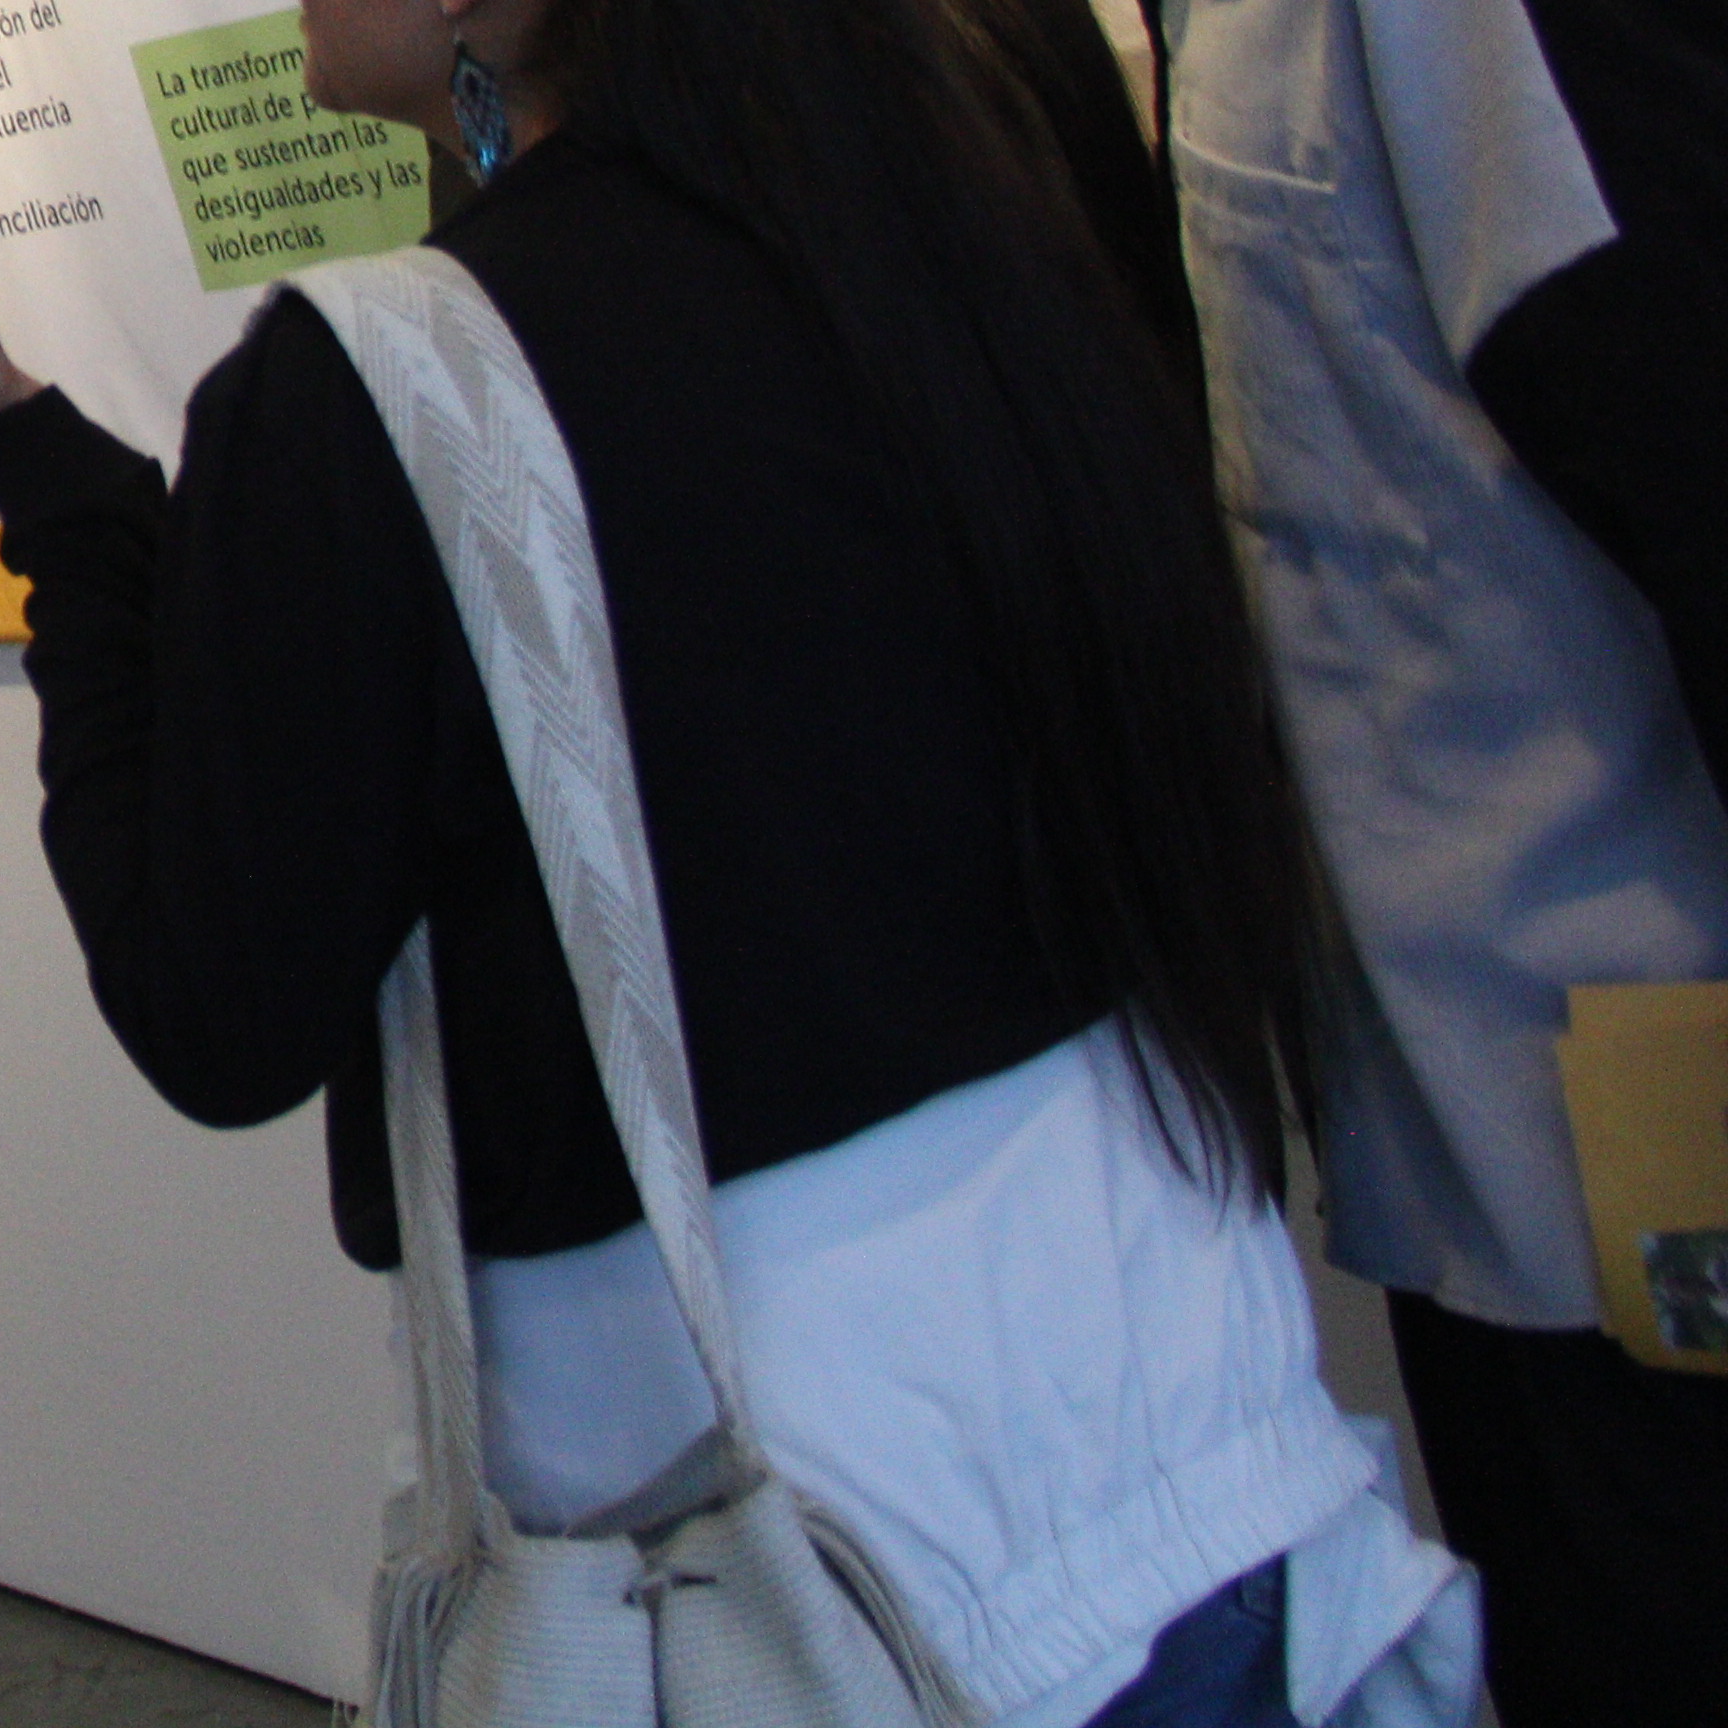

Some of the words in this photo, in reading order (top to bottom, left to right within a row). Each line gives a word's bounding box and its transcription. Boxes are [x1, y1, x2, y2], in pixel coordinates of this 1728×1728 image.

[156, 72, 186, 98] La
[171, 97, 261, 140] cultural
[264, 93, 293, 121] de
[183, 153, 228, 186] que
[235, 130, 349, 171] sustentan
[352, 113, 389, 148] las
[195, 171, 364, 223] desigualdades
[386, 160, 422, 188] las
[206, 225, 325, 263] violencias
